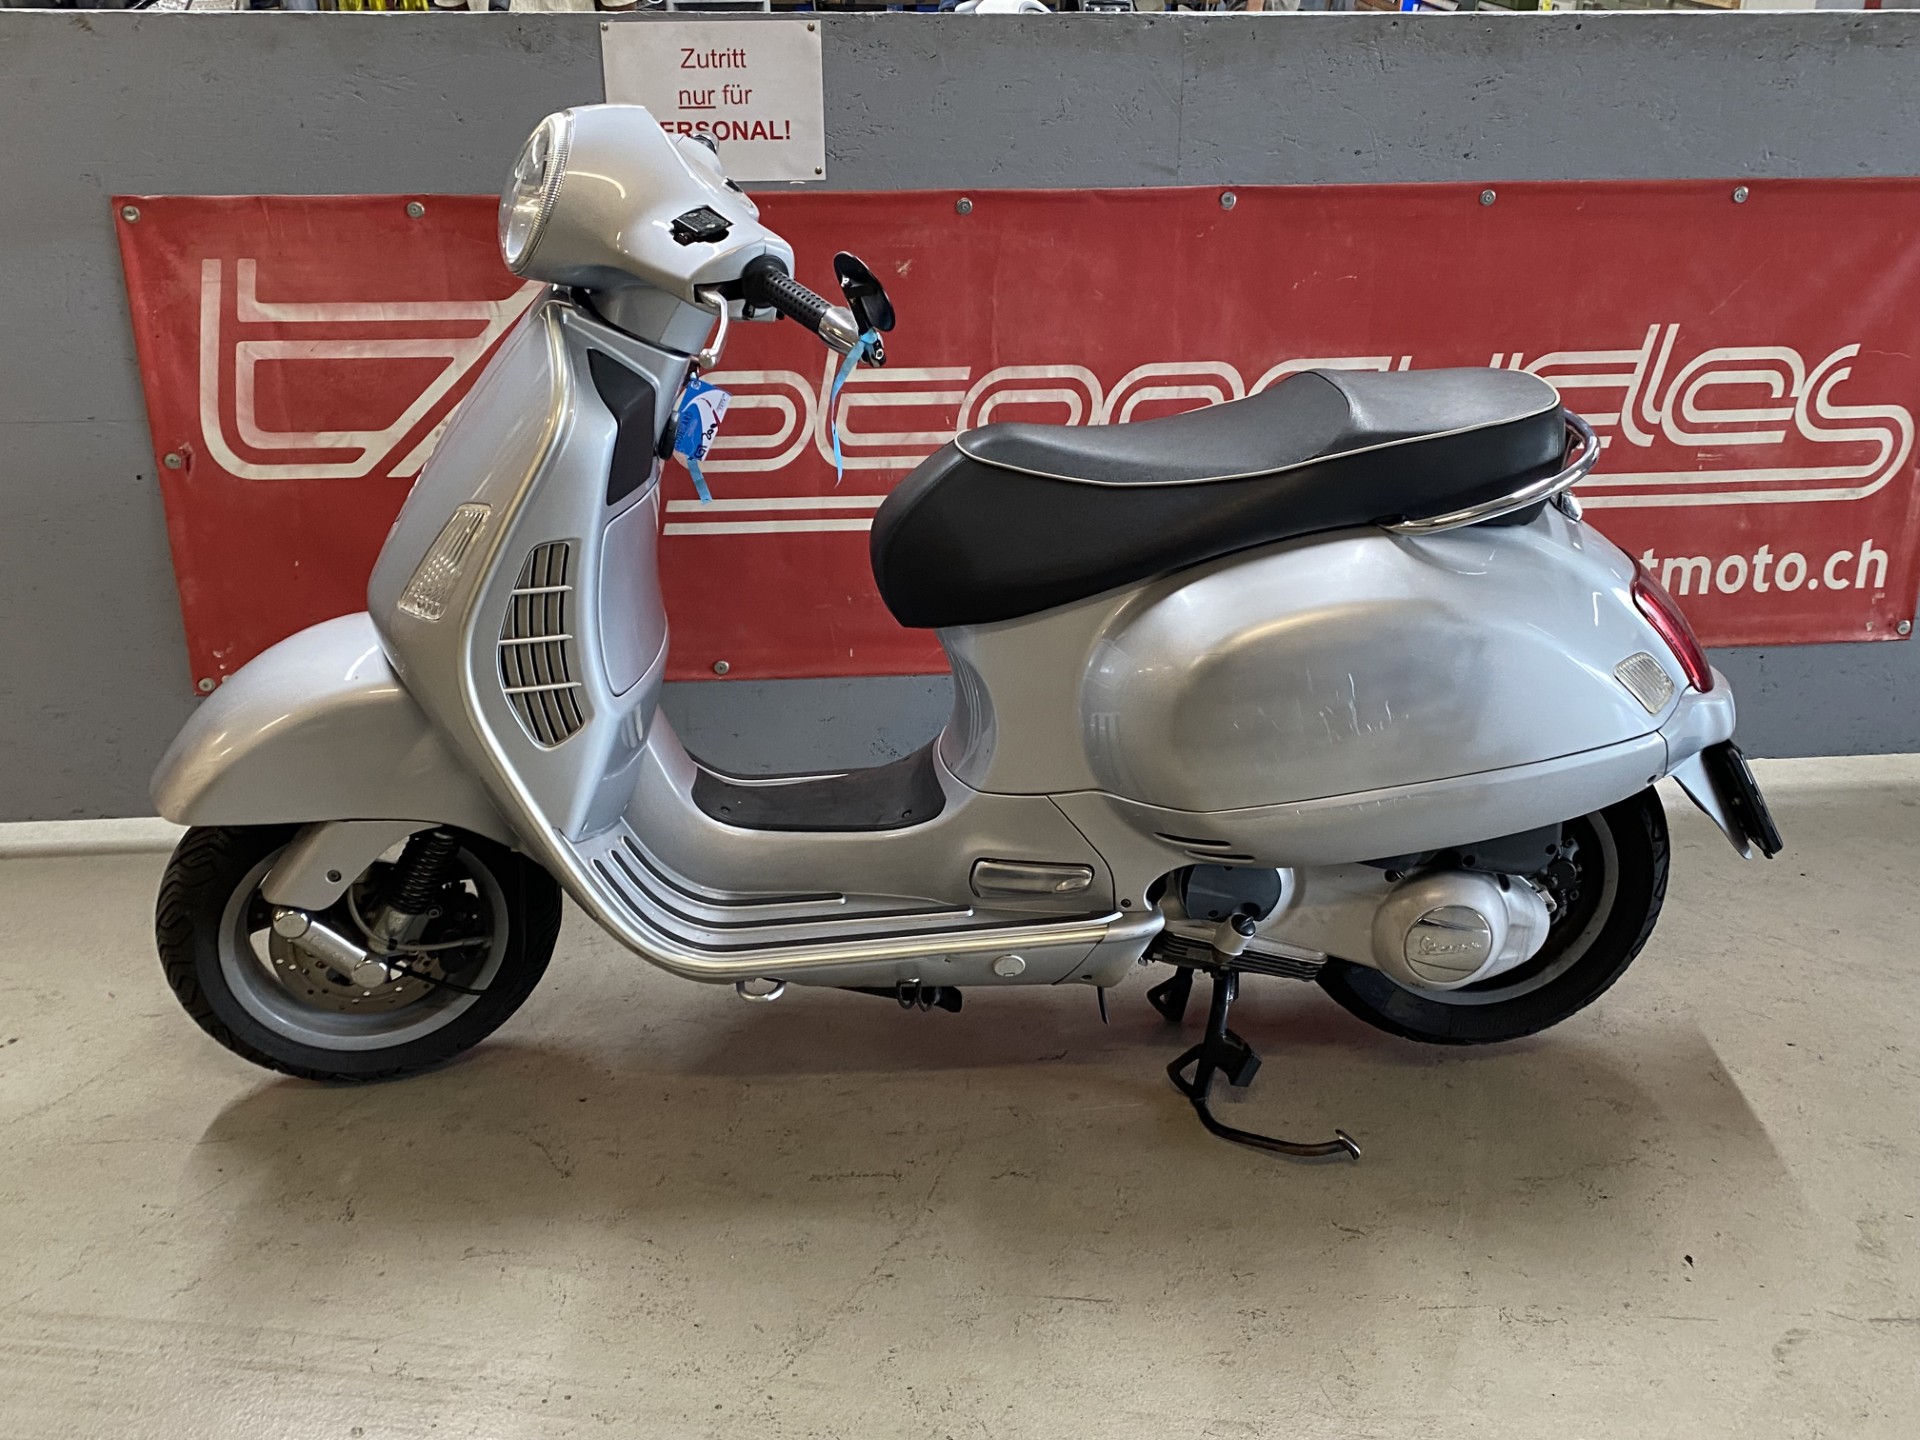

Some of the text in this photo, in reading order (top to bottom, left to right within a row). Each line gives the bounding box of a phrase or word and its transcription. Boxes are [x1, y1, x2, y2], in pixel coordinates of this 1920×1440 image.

[680, 47, 747, 69] Zutritt
[678, 84, 753, 109] nur für
[659, 120, 791, 141] ERSONAL!
